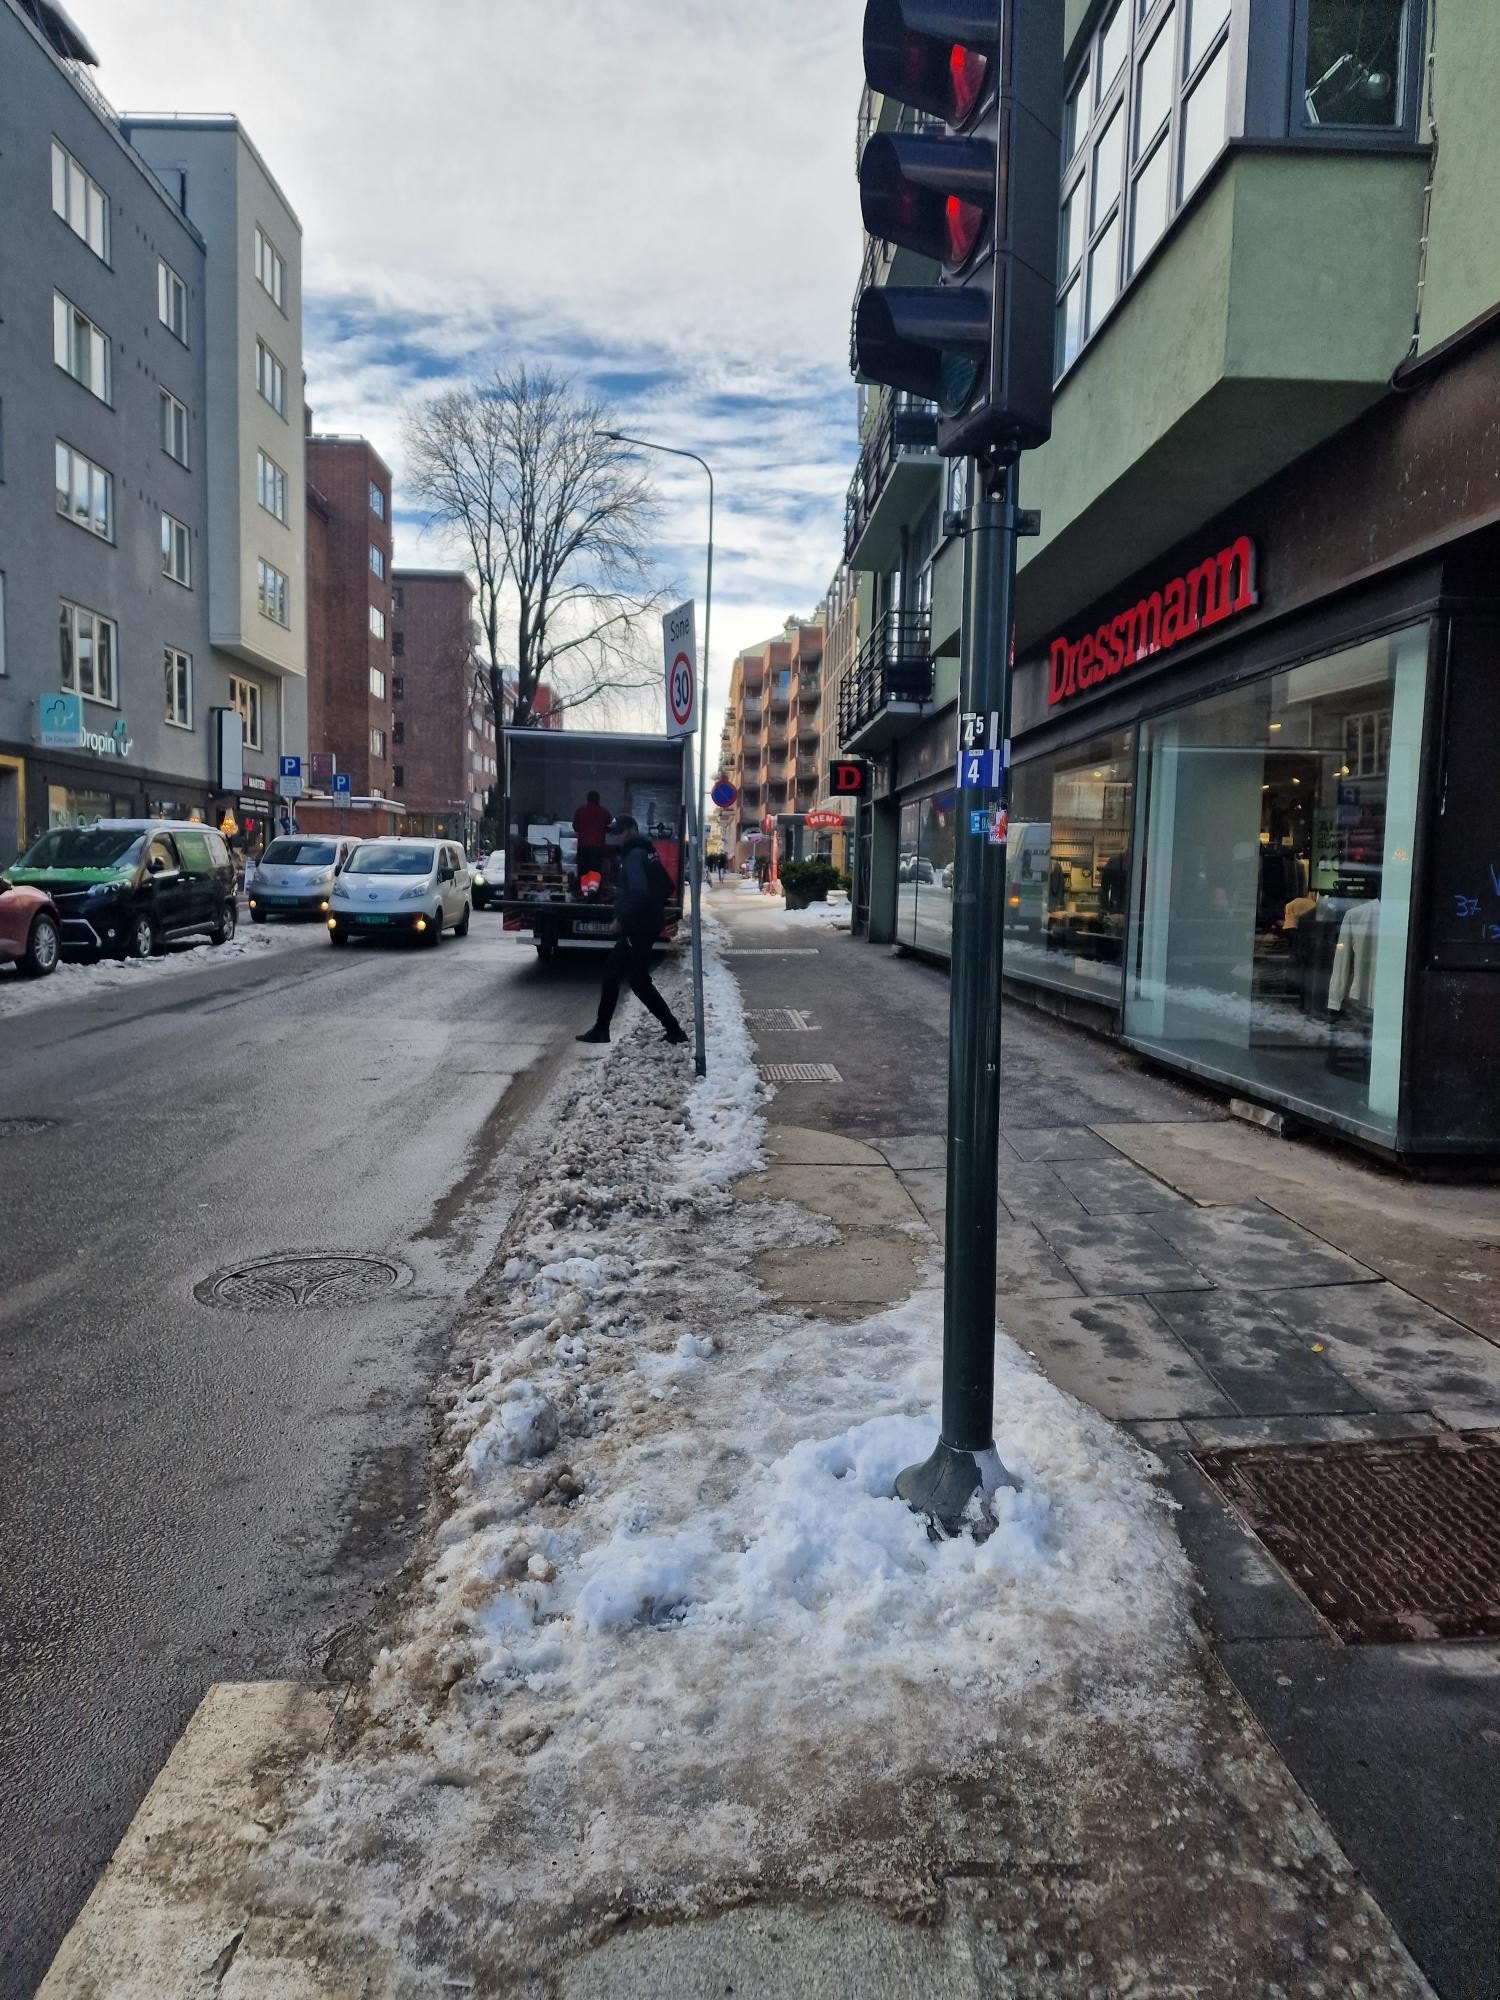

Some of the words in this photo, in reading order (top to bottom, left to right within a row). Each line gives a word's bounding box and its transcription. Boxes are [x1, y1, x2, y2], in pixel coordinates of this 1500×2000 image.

[670, 619, 690, 642] Sone
[1048, 536, 1257, 704] Dressmann
[675, 670, 689, 708] 30
[80, 726, 116, 755] Dropin
[285, 759, 296, 774] P
[837, 765, 862, 790] D
[967, 758, 980, 784] 4
[337, 776, 346, 790] P
[810, 814, 840, 824] MENY
